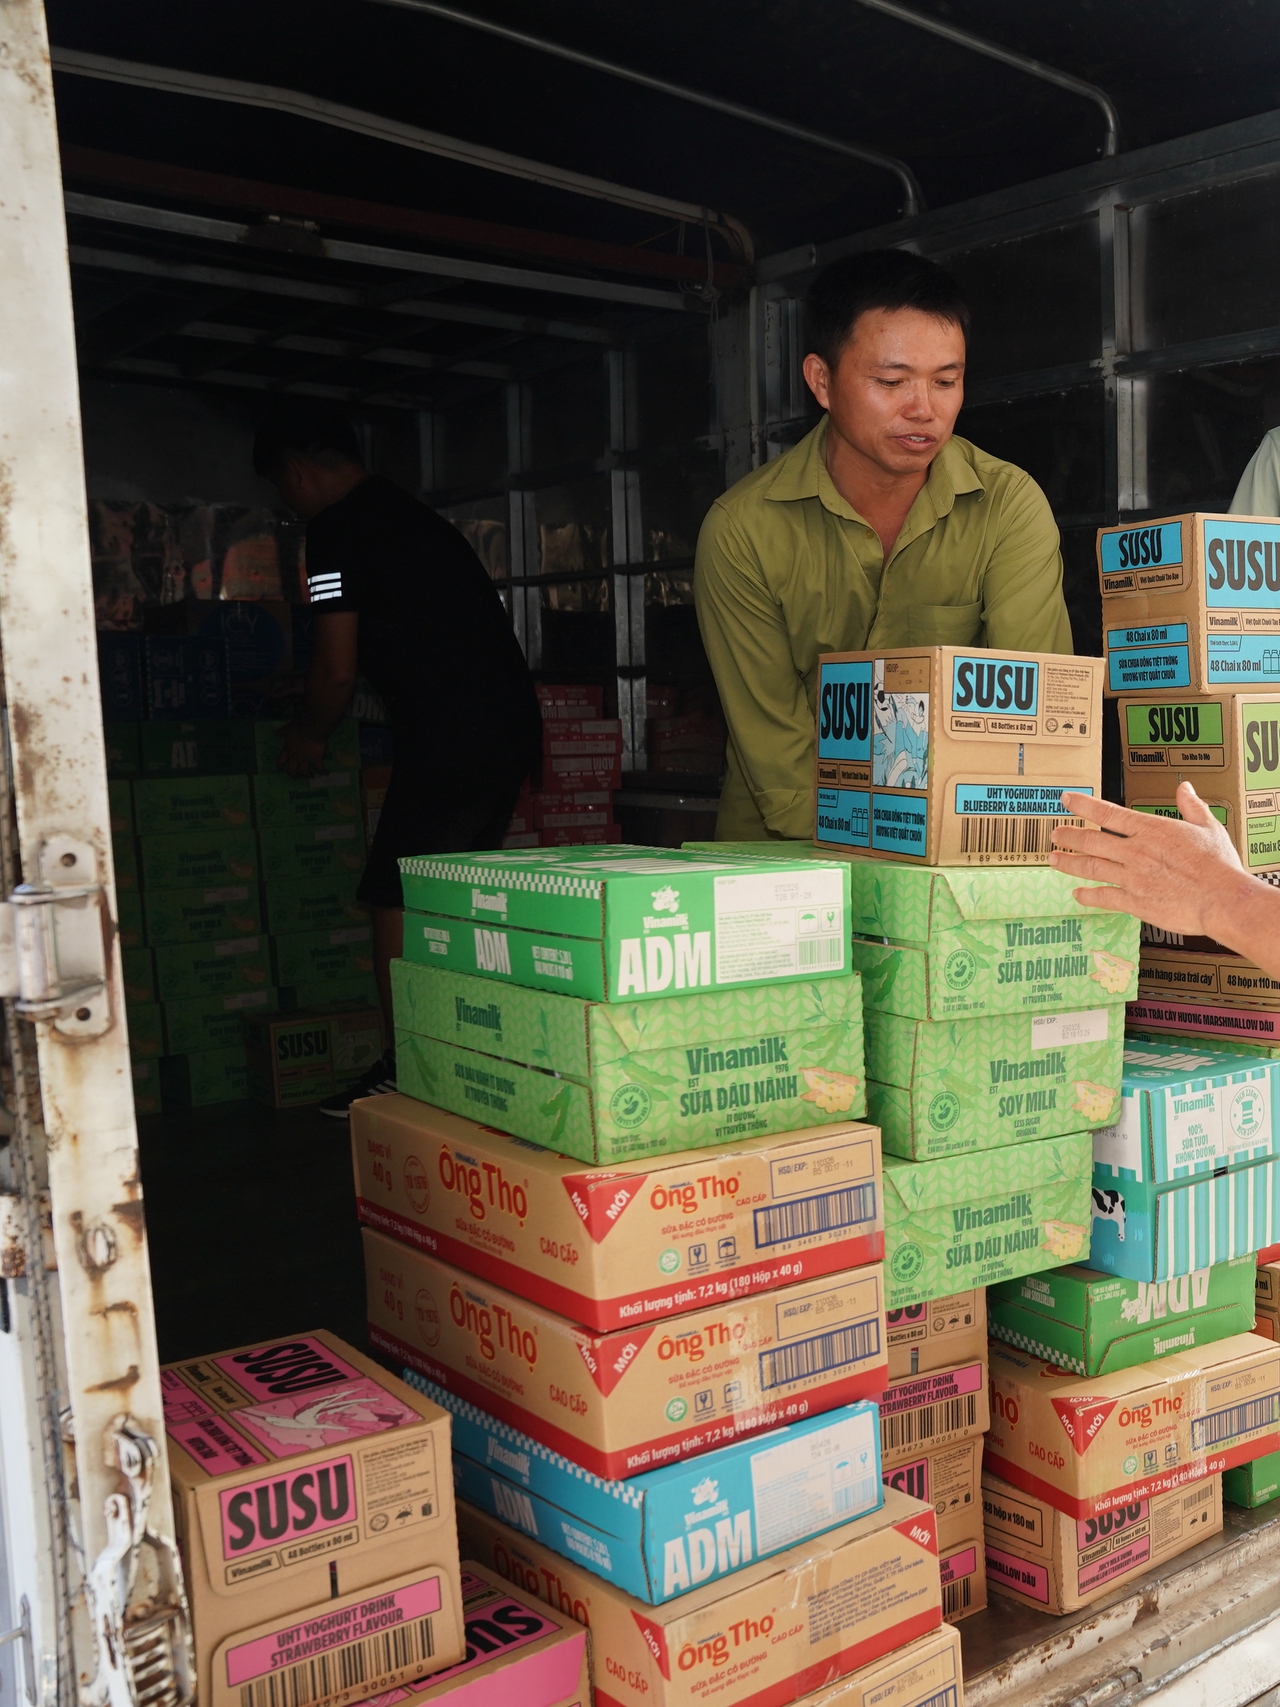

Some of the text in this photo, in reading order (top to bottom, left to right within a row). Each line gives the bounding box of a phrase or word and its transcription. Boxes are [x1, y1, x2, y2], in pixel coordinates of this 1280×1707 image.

[1118, 528, 1162, 567] SUSU
[1105, 576, 1133, 590] Vinamilk
[219, 608, 260, 634] ICY
[1126, 632, 1133, 642] 48
[1134, 631, 1146, 641] Chai
[1151, 629, 1159, 640] 80
[1160, 628, 1167, 639] ml
[1210, 617, 1238, 626] Vinamilk
[1211, 660, 1219, 671] 48
[1221, 660, 1235, 671] Chai
[1242, 660, 1250, 671] 80
[1252, 660, 1261, 671] ml
[957, 662, 1034, 710] SUSU
[821, 682, 870, 740] SUSU
[955, 720, 981, 728] Vinamilk
[1148, 707, 1199, 742] SUSU
[1131, 751, 1165, 762] Vinamilk
[987, 788, 1063, 799] UHT YOGHURT DRINK
[1248, 798, 1273, 808] Vinamilk
[1251, 844, 1258, 854] 48
[1259, 842, 1272, 853] Chai
[643, 914, 688, 929] Vinamilk
[1006, 920, 1082, 947] Vinamilk
[474, 928, 511, 975] ADM
[618, 932, 711, 996] ADM
[1024, 957, 1050, 982] ĐẬU
[456, 997, 501, 1031] Vinamilk
[278, 1029, 328, 1061] SUSU
[686, 1037, 788, 1075] Vinamilk
[688, 1064, 788, 1087] EST 1976
[990, 1052, 1066, 1084] Vinamilk
[680, 1089, 713, 1117] SỮA
[717, 1083, 750, 1111] ĐẬU
[999, 1089, 1056, 1118] SOY MILK
[1174, 1093, 1214, 1114] Vinamilk
[1014, 1117, 1040, 1128] LESS SUGAR
[1188, 1124, 1203, 1135] 100%
[440, 1143, 528, 1228] Ông Thọ
[650, 1175, 739, 1214] Ông Thọ
[571, 1192, 589, 1220] MỚI
[606, 1189, 630, 1220] MỚI
[953, 1194, 1032, 1232] Vinamilk
[540, 1237, 578, 1266] CAO CẤP
[974, 1238, 1002, 1264] ĐẬU
[619, 1261, 803, 1318] Khối lượng tịnh: 7,2 kg (180 Hộp x 40 g)
[451, 1281, 537, 1374] Ông Thọ
[657, 1322, 745, 1362] Ông Thọ
[1154, 1331, 1195, 1355] Vinamilk
[233, 1343, 349, 1394] SUSU
[613, 1342, 638, 1373] MỚI
[550, 1384, 588, 1416] CAO CẤP
[879, 1384, 958, 1416] STRAWBERRY FLAVOUR
[882, 1374, 954, 1402] UHT YOGHURT DRINK
[1061, 1414, 1075, 1438] MỚI
[1086, 1413, 1104, 1437] MỚI
[1118, 1396, 1182, 1428] Ông Thọ
[1028, 1441, 1065, 1470] CAO CẤP
[228, 1463, 350, 1551] SUSU
[491, 1478, 538, 1535] ADM
[685, 1499, 728, 1530] Vinamilk
[984, 1501, 1034, 1531] 48 hộp x 180 ml
[909, 1524, 931, 1545] MỚI
[231, 1558, 273, 1578] Vinamilk
[663, 1510, 753, 1597] ADM
[1082, 1543, 1109, 1563] Vinamilk
[277, 1595, 396, 1648] UHT YOGHURT DRINK
[271, 1608, 403, 1668] STRAWBERRY FLAVOUR
[678, 1614, 774, 1671] Ông Thọ
[607, 1657, 648, 1695] CAO CẤP
